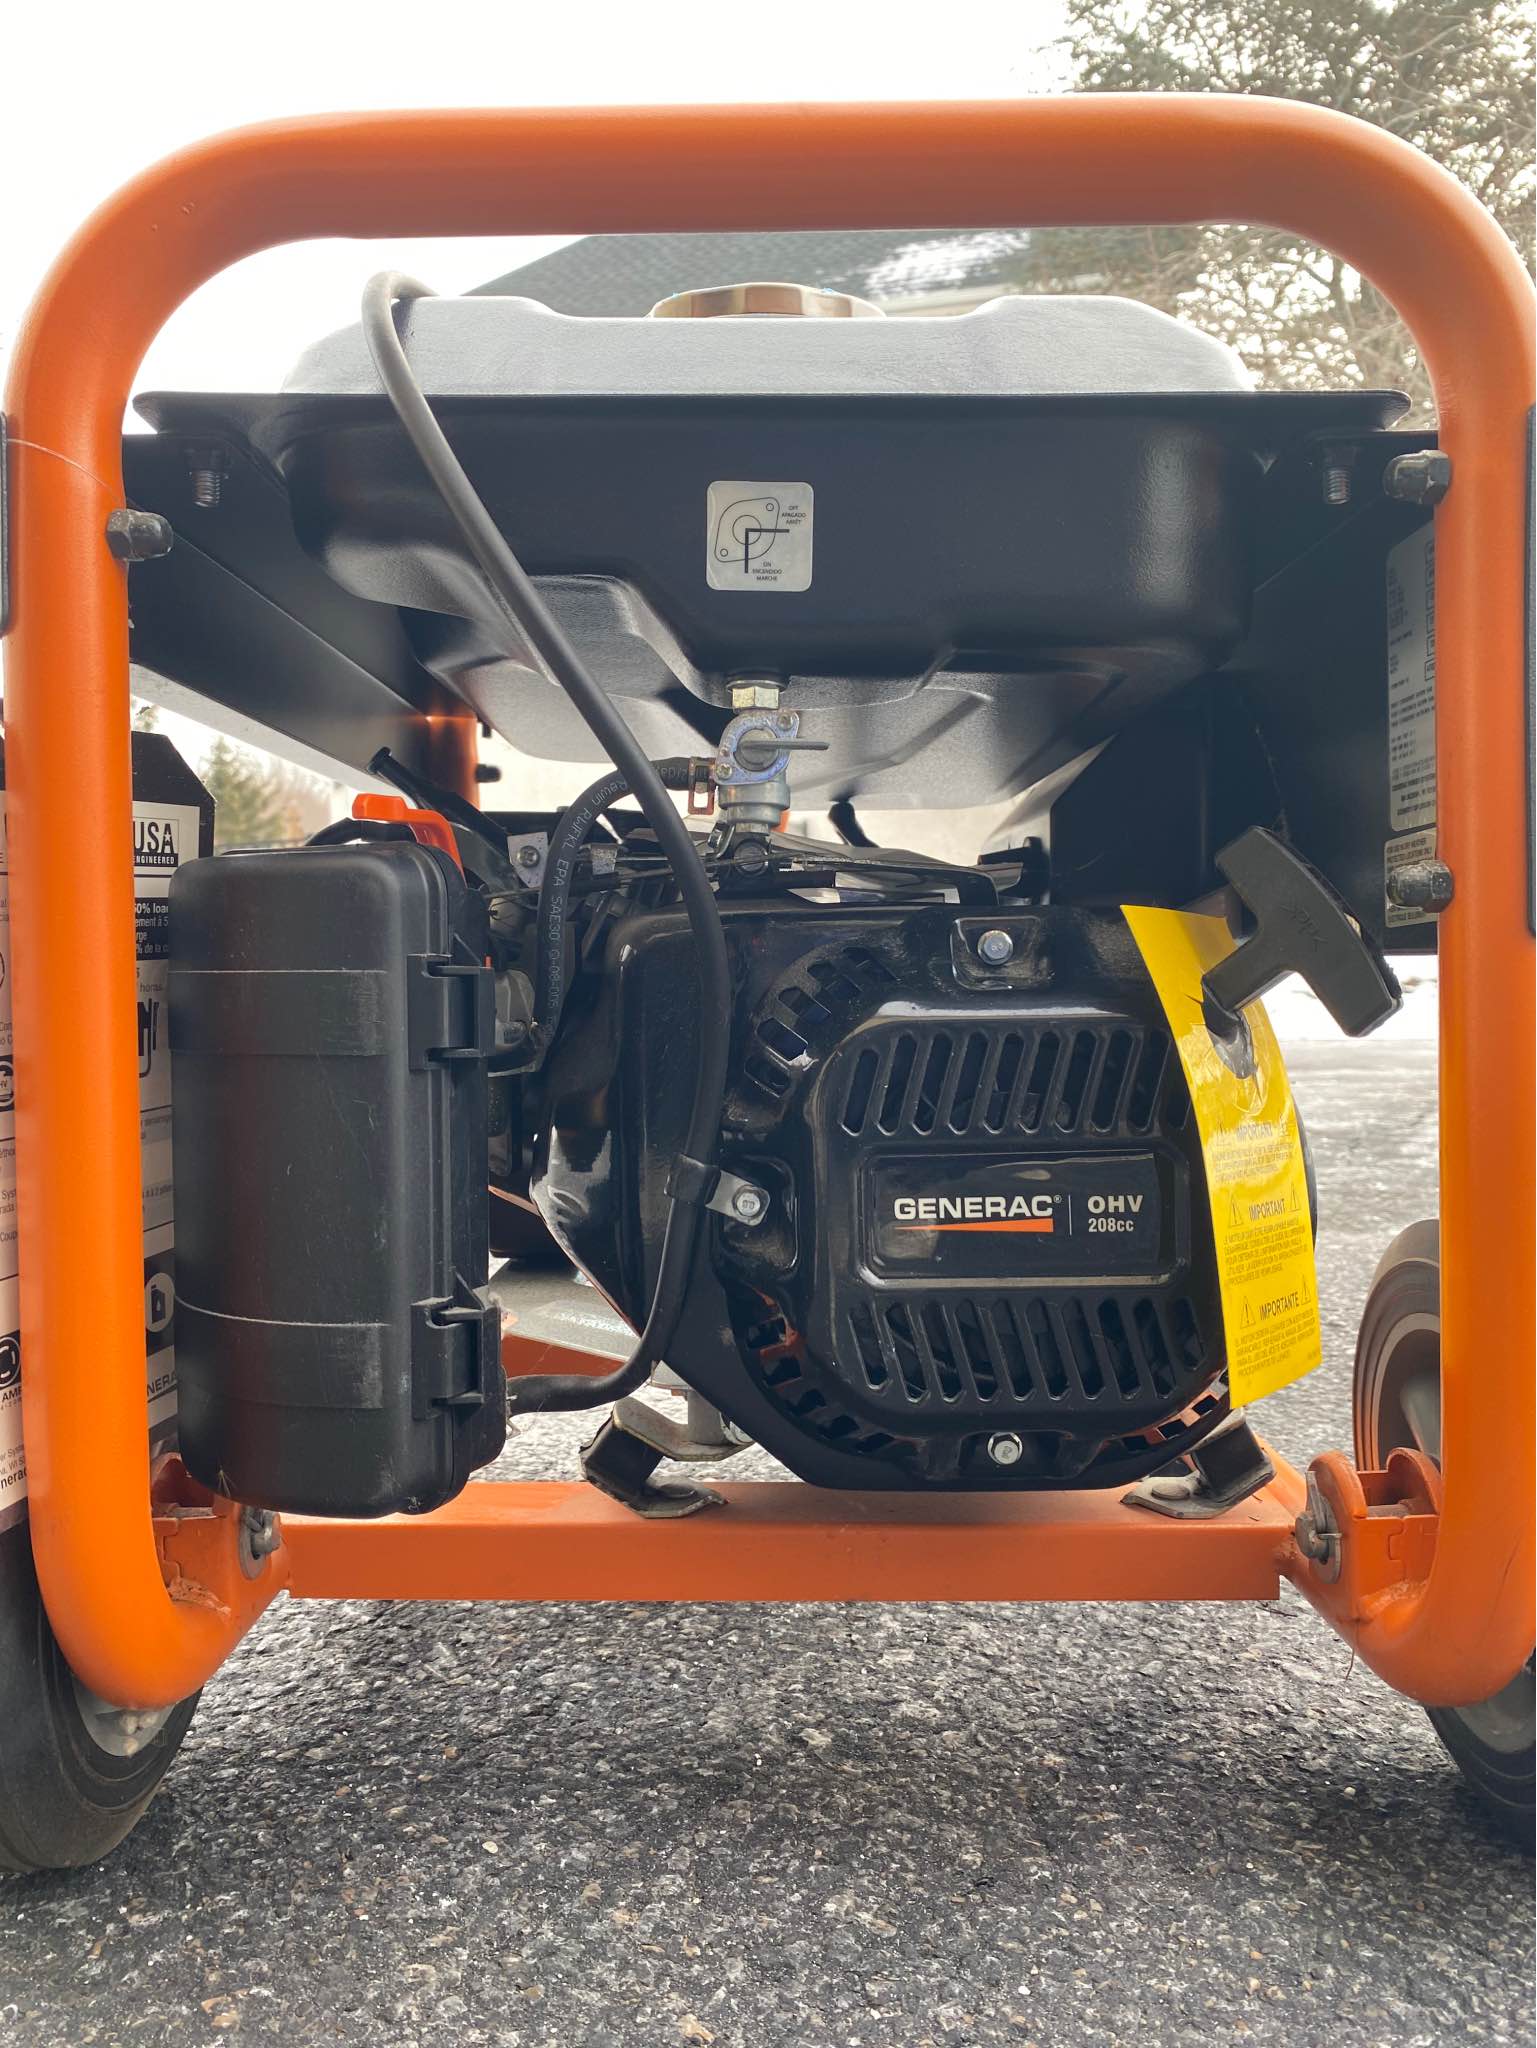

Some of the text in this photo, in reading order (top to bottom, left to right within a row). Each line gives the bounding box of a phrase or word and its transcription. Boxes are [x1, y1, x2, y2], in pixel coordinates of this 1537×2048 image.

[133, 820, 175, 854] USA
[553, 859, 569, 887] EPA
[1087, 1195, 1143, 1214] OHV
[1248, 1198, 1286, 1222] IMPORTANT
[1088, 1217, 1135, 1233] 208cc
[1259, 1291, 1300, 1321] IMPORTANTE
